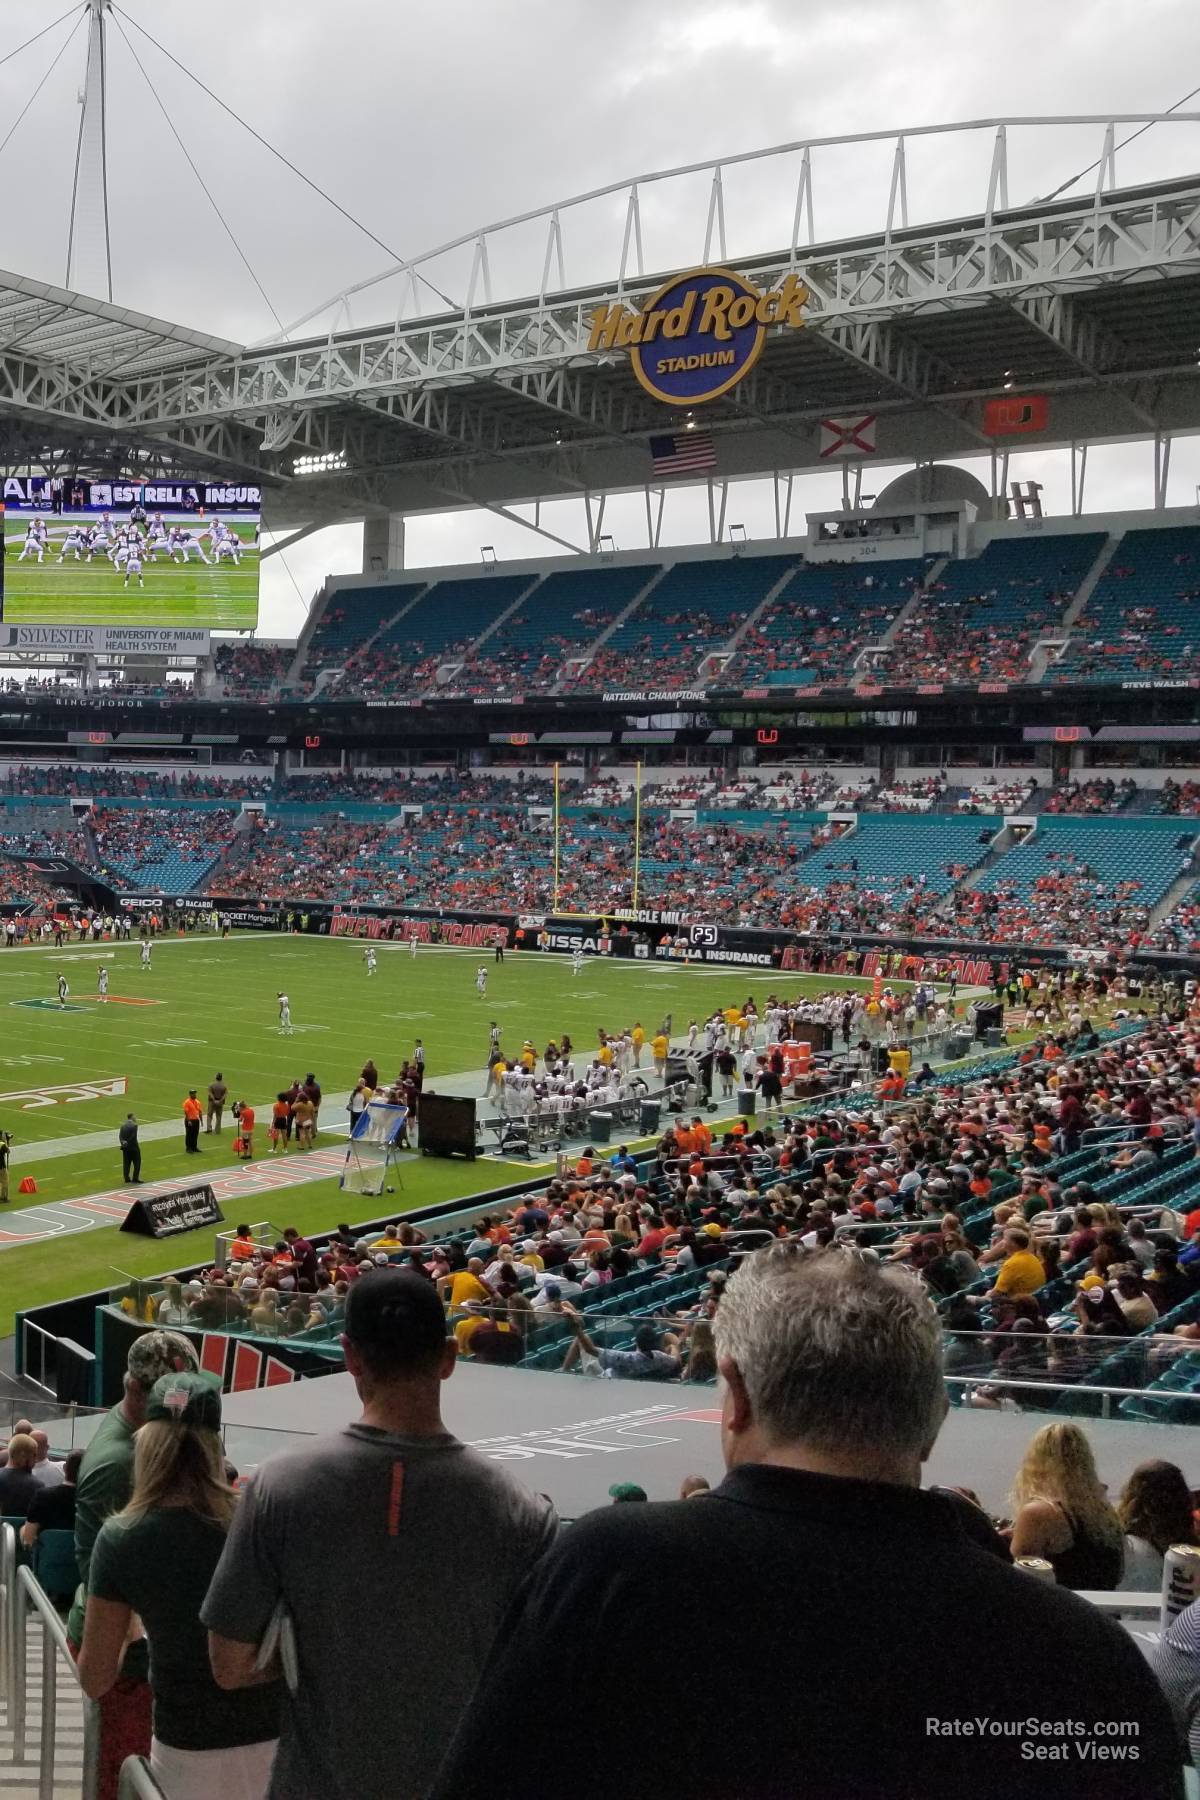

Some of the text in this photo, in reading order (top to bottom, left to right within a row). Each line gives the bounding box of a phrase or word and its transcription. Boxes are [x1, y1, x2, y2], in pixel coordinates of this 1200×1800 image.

[587, 274, 810, 351] Hard Rock
[656, 350, 735, 375] STADIUM
[19, 628, 94, 644] SYLVESTER
[105, 629, 204, 641] UNIVERSITY OF MIAMI
[105, 641, 176, 651] HEALTH SYSTEM
[1122, 680, 1188, 689] STEVE WALSH
[602, 690, 706, 702] NATIONAL CHAMPIONS
[119, 898, 163, 907] GEICO
[219, 911, 247, 921] ROCKET
[614, 908, 659, 923] MUSCLE
[706, 950, 771, 965] INSURANCE
